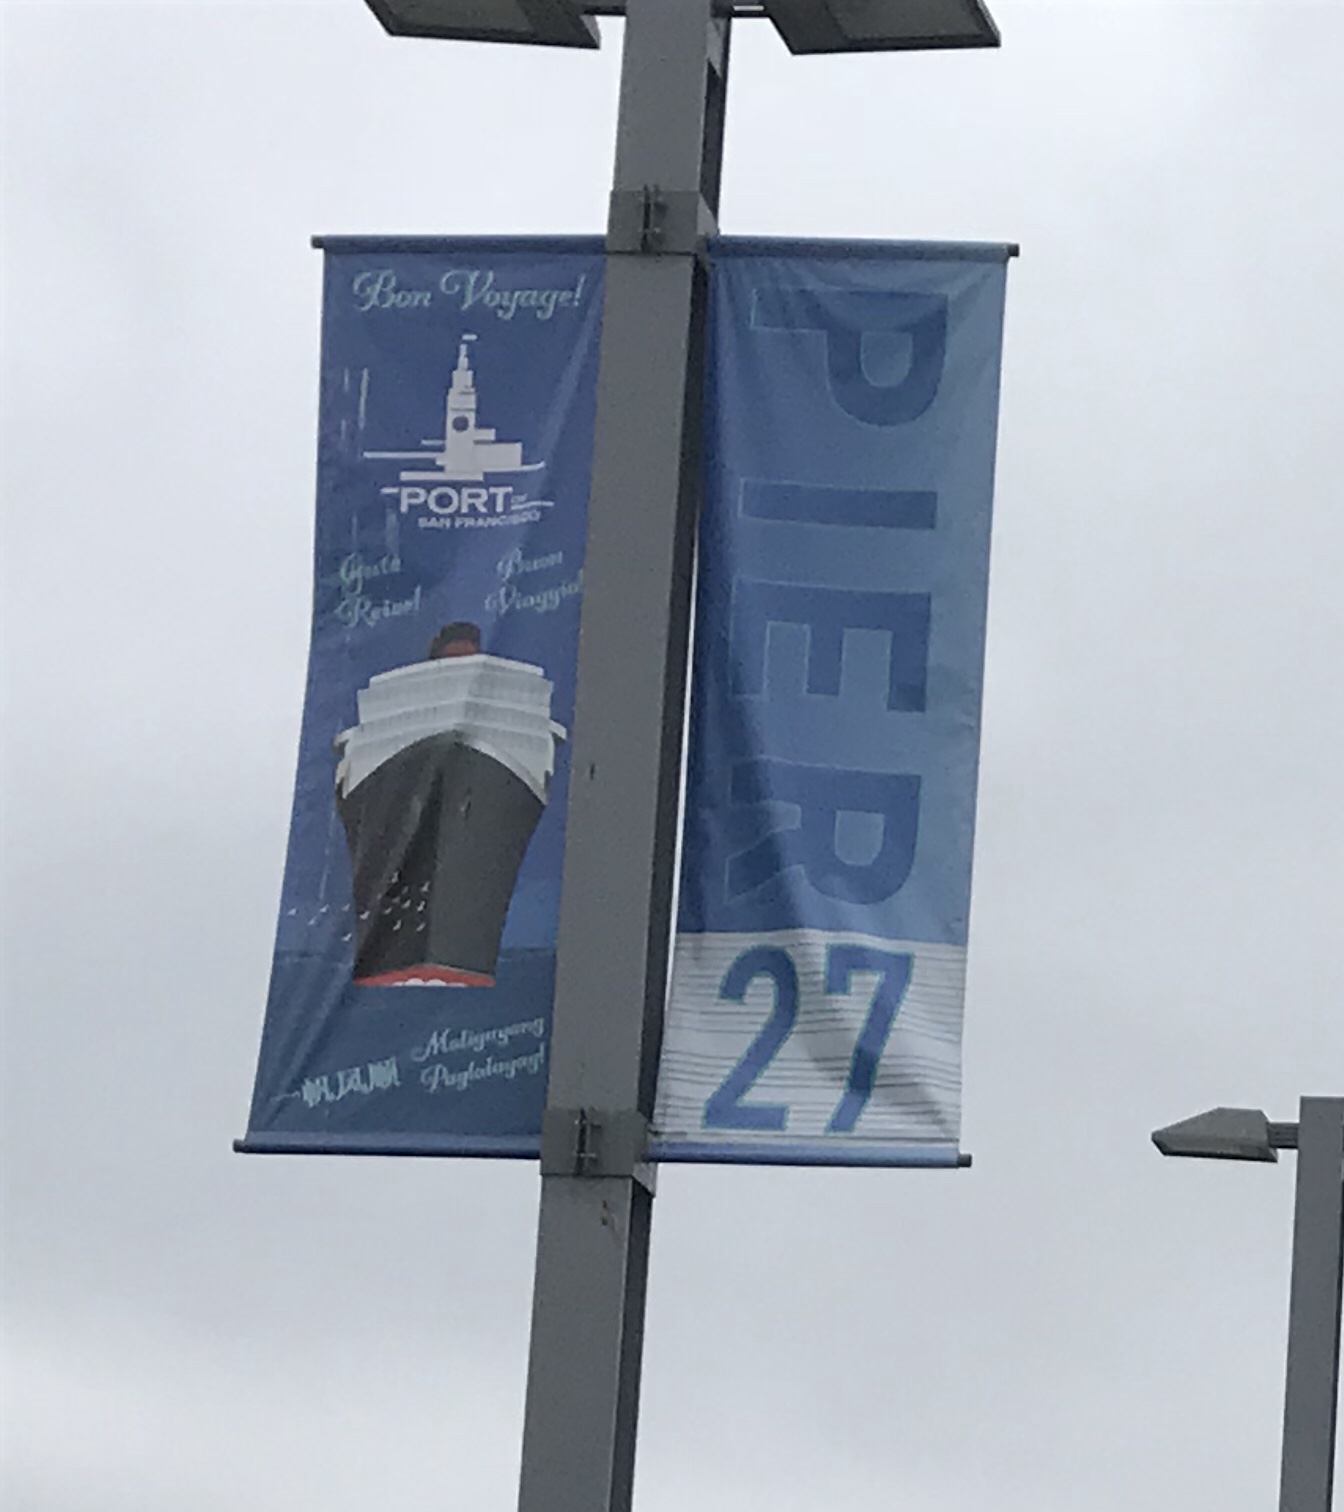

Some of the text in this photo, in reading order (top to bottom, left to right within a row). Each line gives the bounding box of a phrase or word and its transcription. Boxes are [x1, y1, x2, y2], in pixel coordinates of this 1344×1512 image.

[353, 269, 585, 320] Bon Voyage!
[399, 486, 514, 514] PORT
[418, 510, 541, 529] SAN FRANCISCO
[725, 286, 949, 906] PIER
[702, 941, 913, 1136] 27
